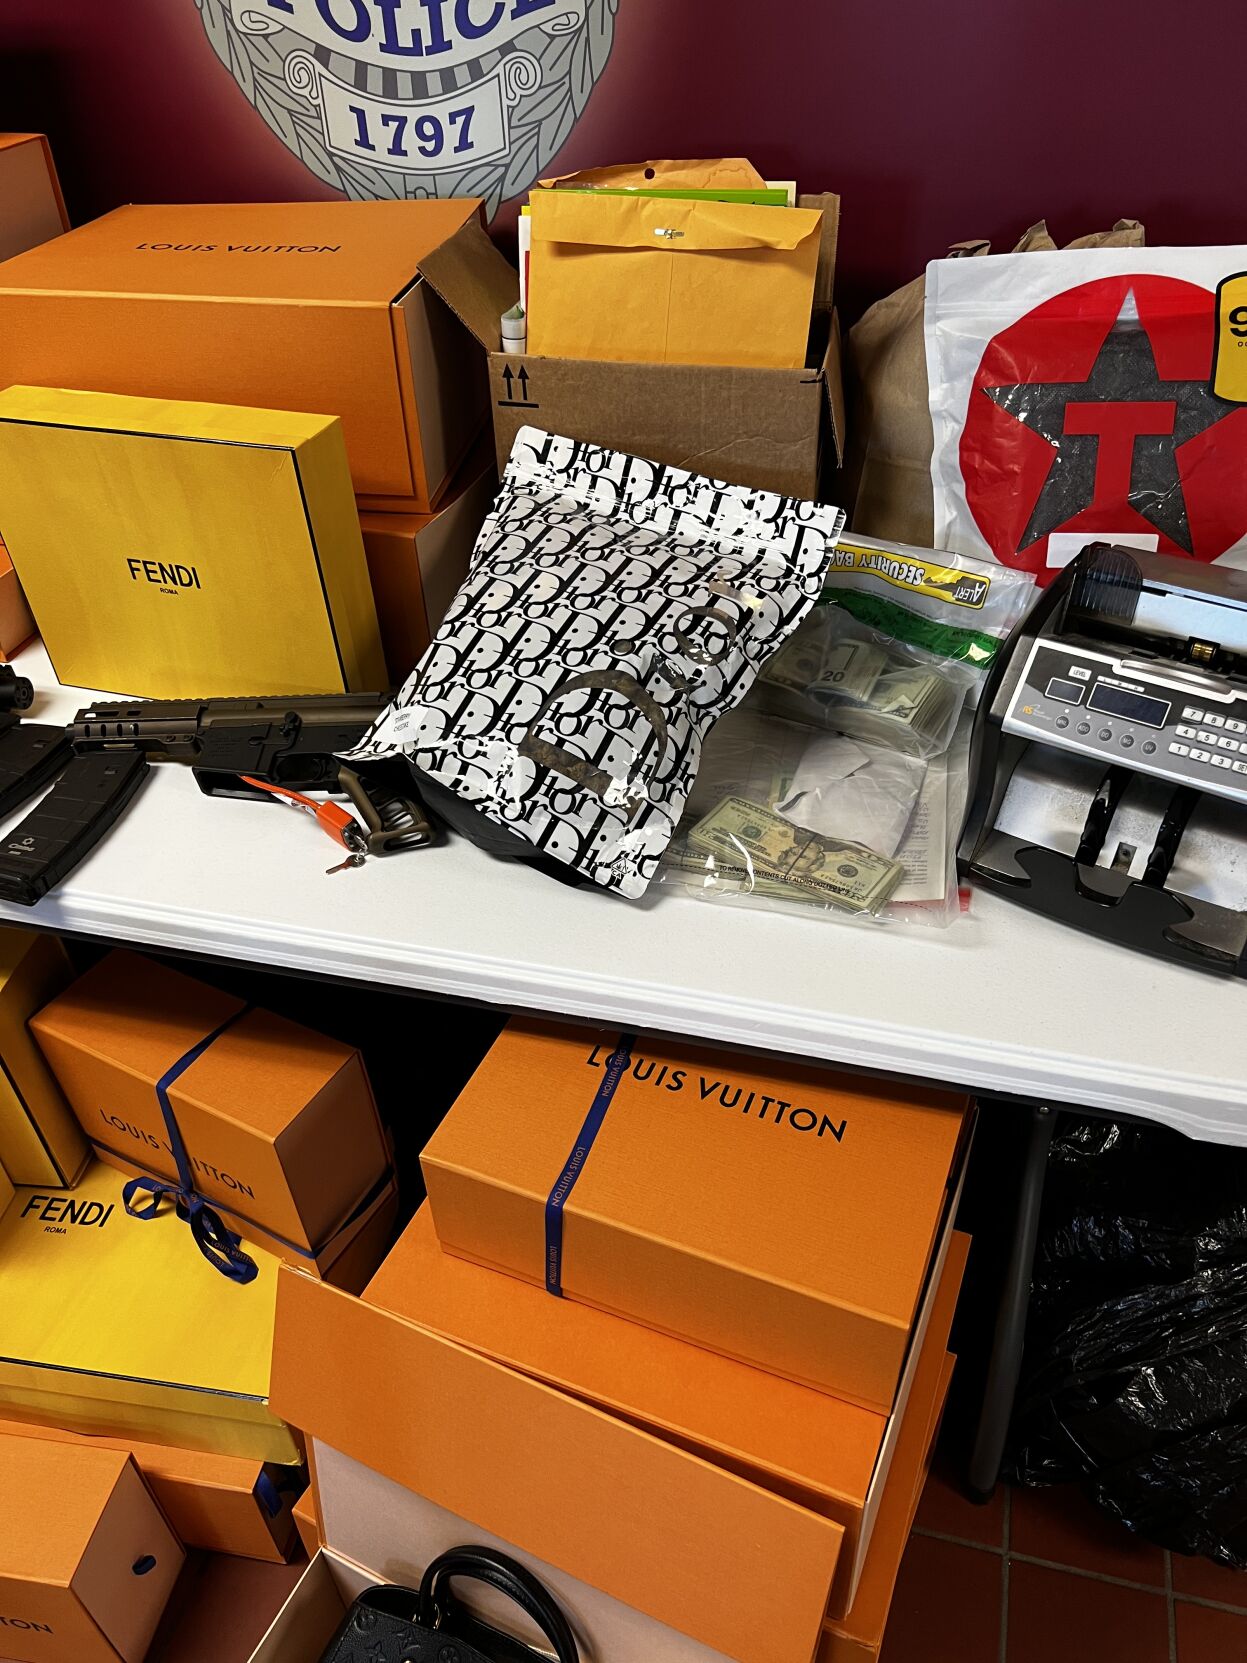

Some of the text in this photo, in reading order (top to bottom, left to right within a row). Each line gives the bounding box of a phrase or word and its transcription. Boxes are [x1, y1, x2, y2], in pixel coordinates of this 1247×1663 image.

[348, 104, 476, 158] 1797
[135, 243, 343, 253] LOUIS VUITTON
[529, 520, 625, 561] Dior
[126, 557, 201, 589] FENDI
[516, 566, 616, 610] Dior
[563, 561, 662, 604] Dior
[609, 552, 711, 598] Dior
[858, 553, 926, 586] SECURITY
[159, 587, 179, 595] ROMA
[468, 575, 568, 618] Dior
[953, 582, 987, 603] ALERT
[460, 627, 560, 678] Dior
[507, 617, 609, 668] Dior
[821, 670, 845, 683] 20
[1218, 758, 1225, 766] 3
[602, 1065, 620, 1097] VUITTON
[99, 1108, 160, 1150] LOUIS
[699, 1076, 848, 1143] VUITTON
[551, 1146, 586, 1207] LOUIS VUITTON
[20, 1195, 115, 1228] FENDI
[43, 1226, 67, 1235] ROMA
